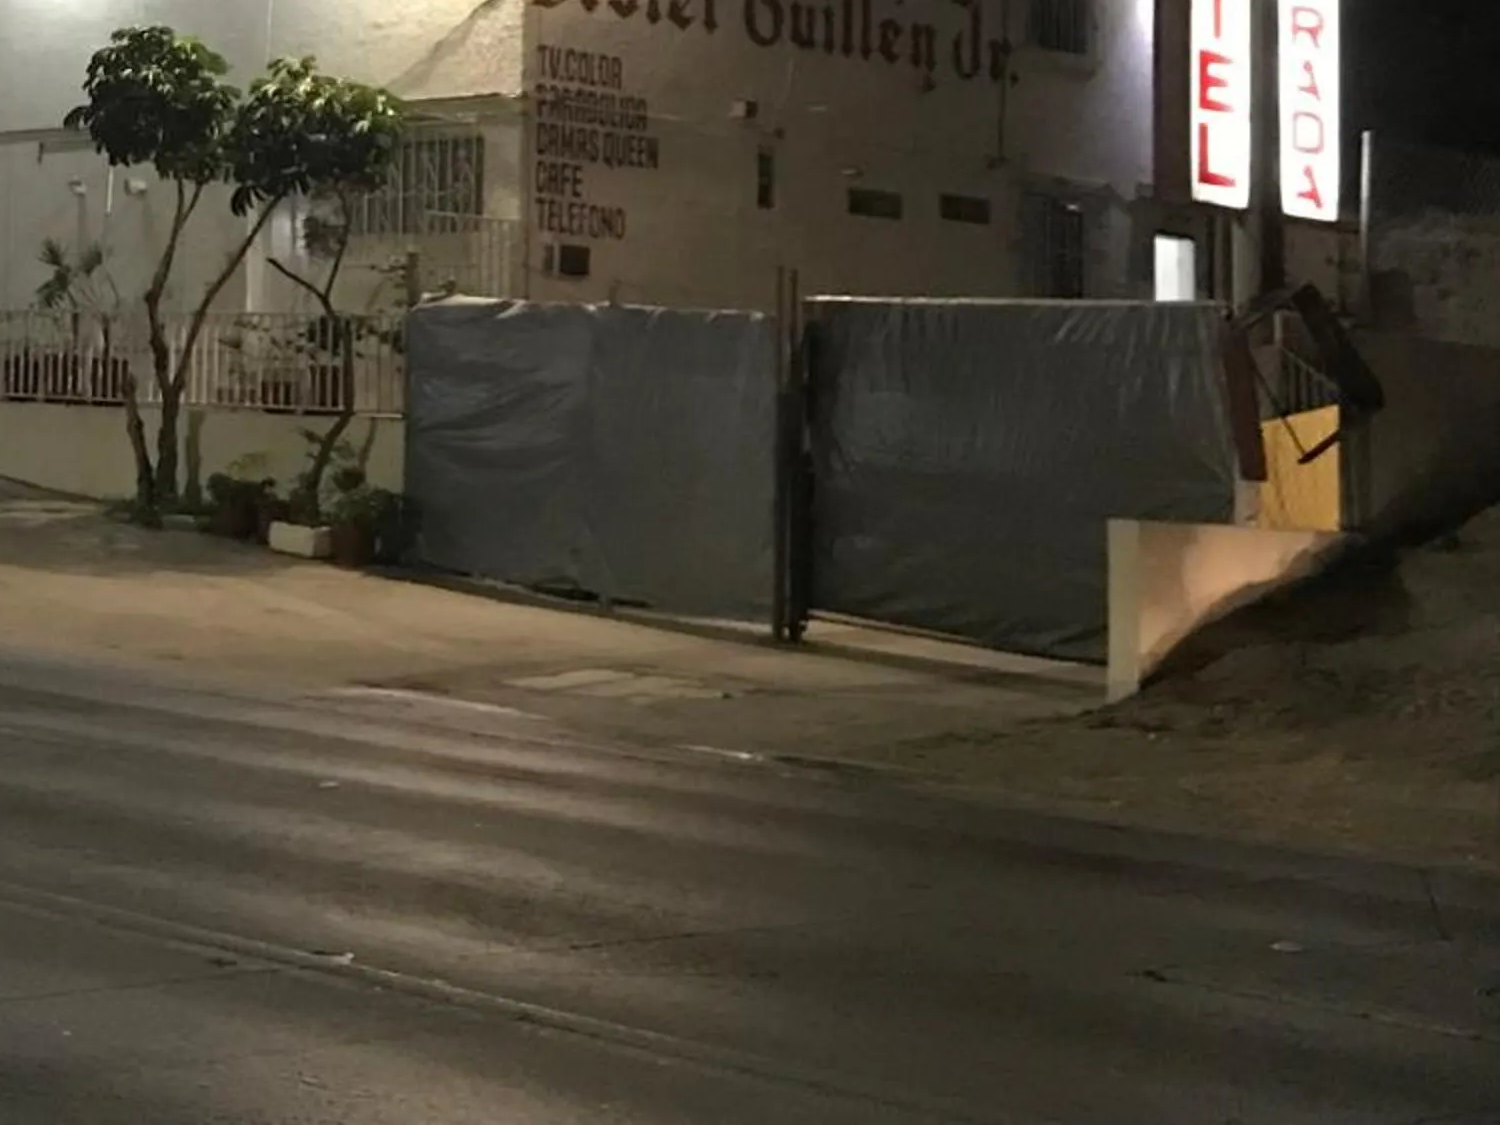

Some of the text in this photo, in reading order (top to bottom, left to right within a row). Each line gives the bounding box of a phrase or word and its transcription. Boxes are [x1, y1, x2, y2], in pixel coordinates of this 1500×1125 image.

[602, 131, 659, 171] QUEEN
[535, 160, 584, 198] CAFE
[535, 197, 626, 241] TELEFONO
